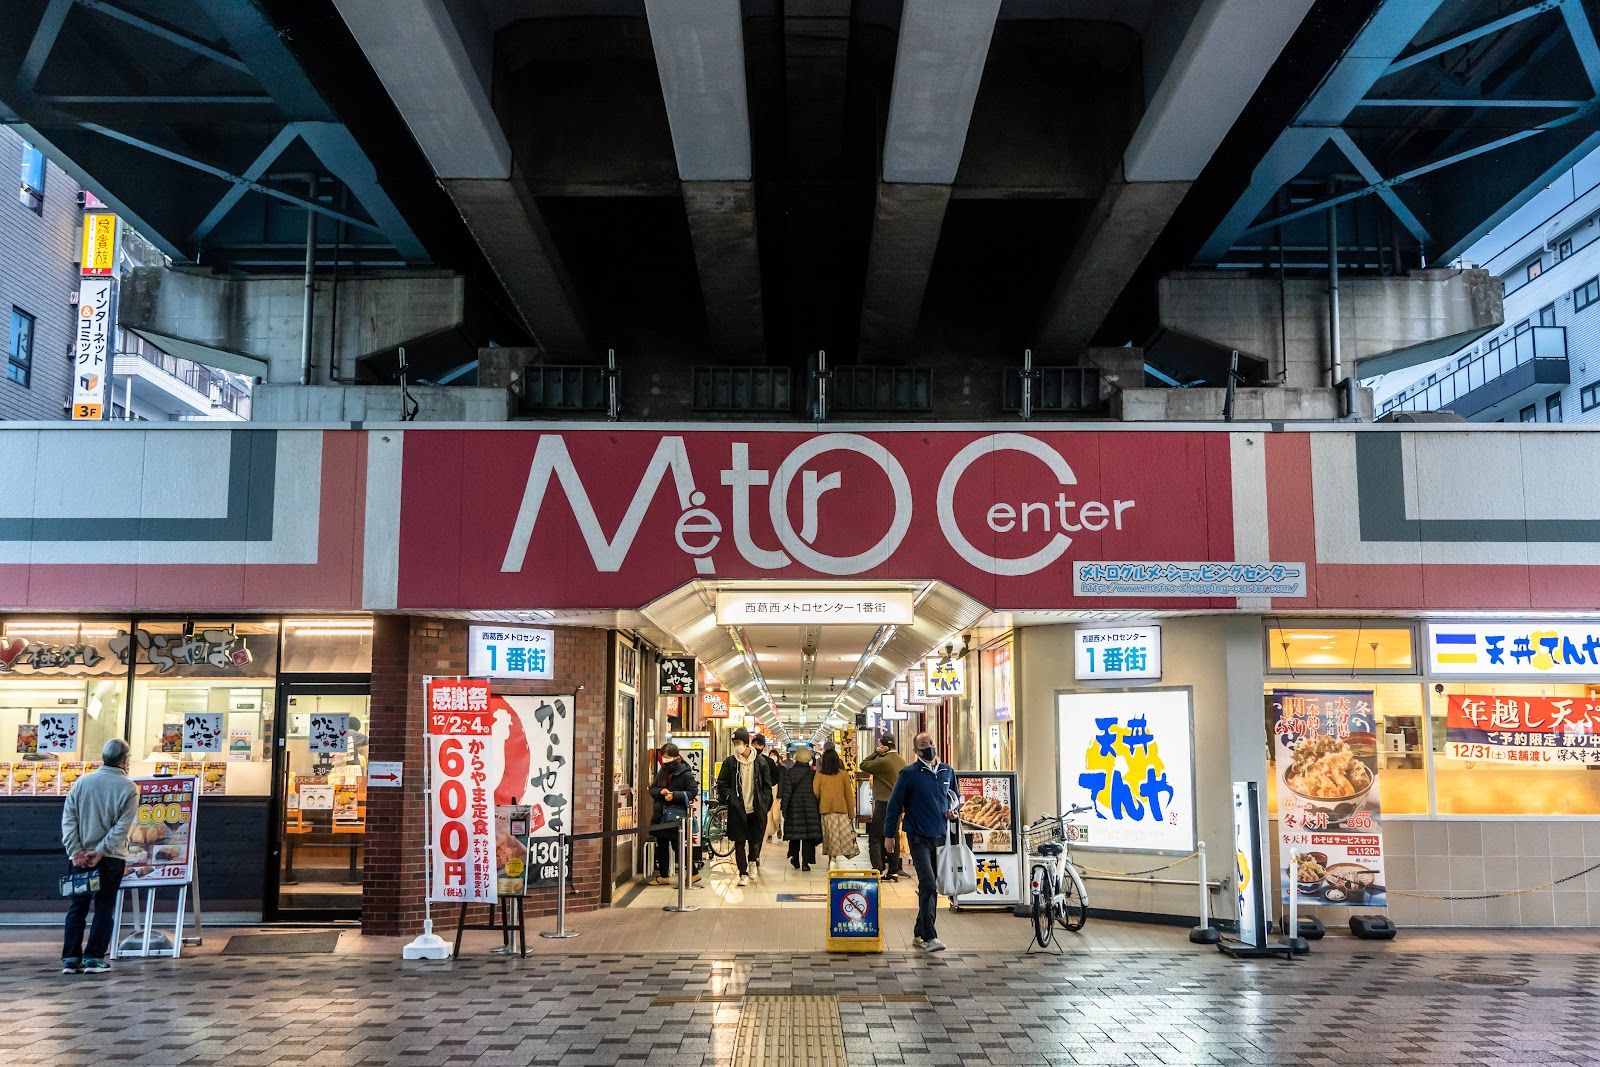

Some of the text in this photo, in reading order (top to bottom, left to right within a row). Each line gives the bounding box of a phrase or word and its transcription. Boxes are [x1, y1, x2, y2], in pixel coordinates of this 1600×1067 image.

[93, 287, 108, 365] インターネット
[80, 406, 97, 417] 3F
[937, 433, 1135, 576] Center
[744, 602, 887, 614] 西葛西メトロセンター1番街
[482, 632, 546, 642] 西葛西メトロセンター
[1082, 633, 1147, 643] 西葛西メトロセンター
[486, 645, 546, 672] 1番街
[1085, 646, 1147, 672] 1番街
[432, 686, 488, 711] 感謝祭
[1487, 732, 1556, 747] ご予約限定
[469, 739, 488, 835] からやま定食
[1078, 768, 1174, 822] てんや
[1313, 836, 1378, 845] 小そばサービスセット
